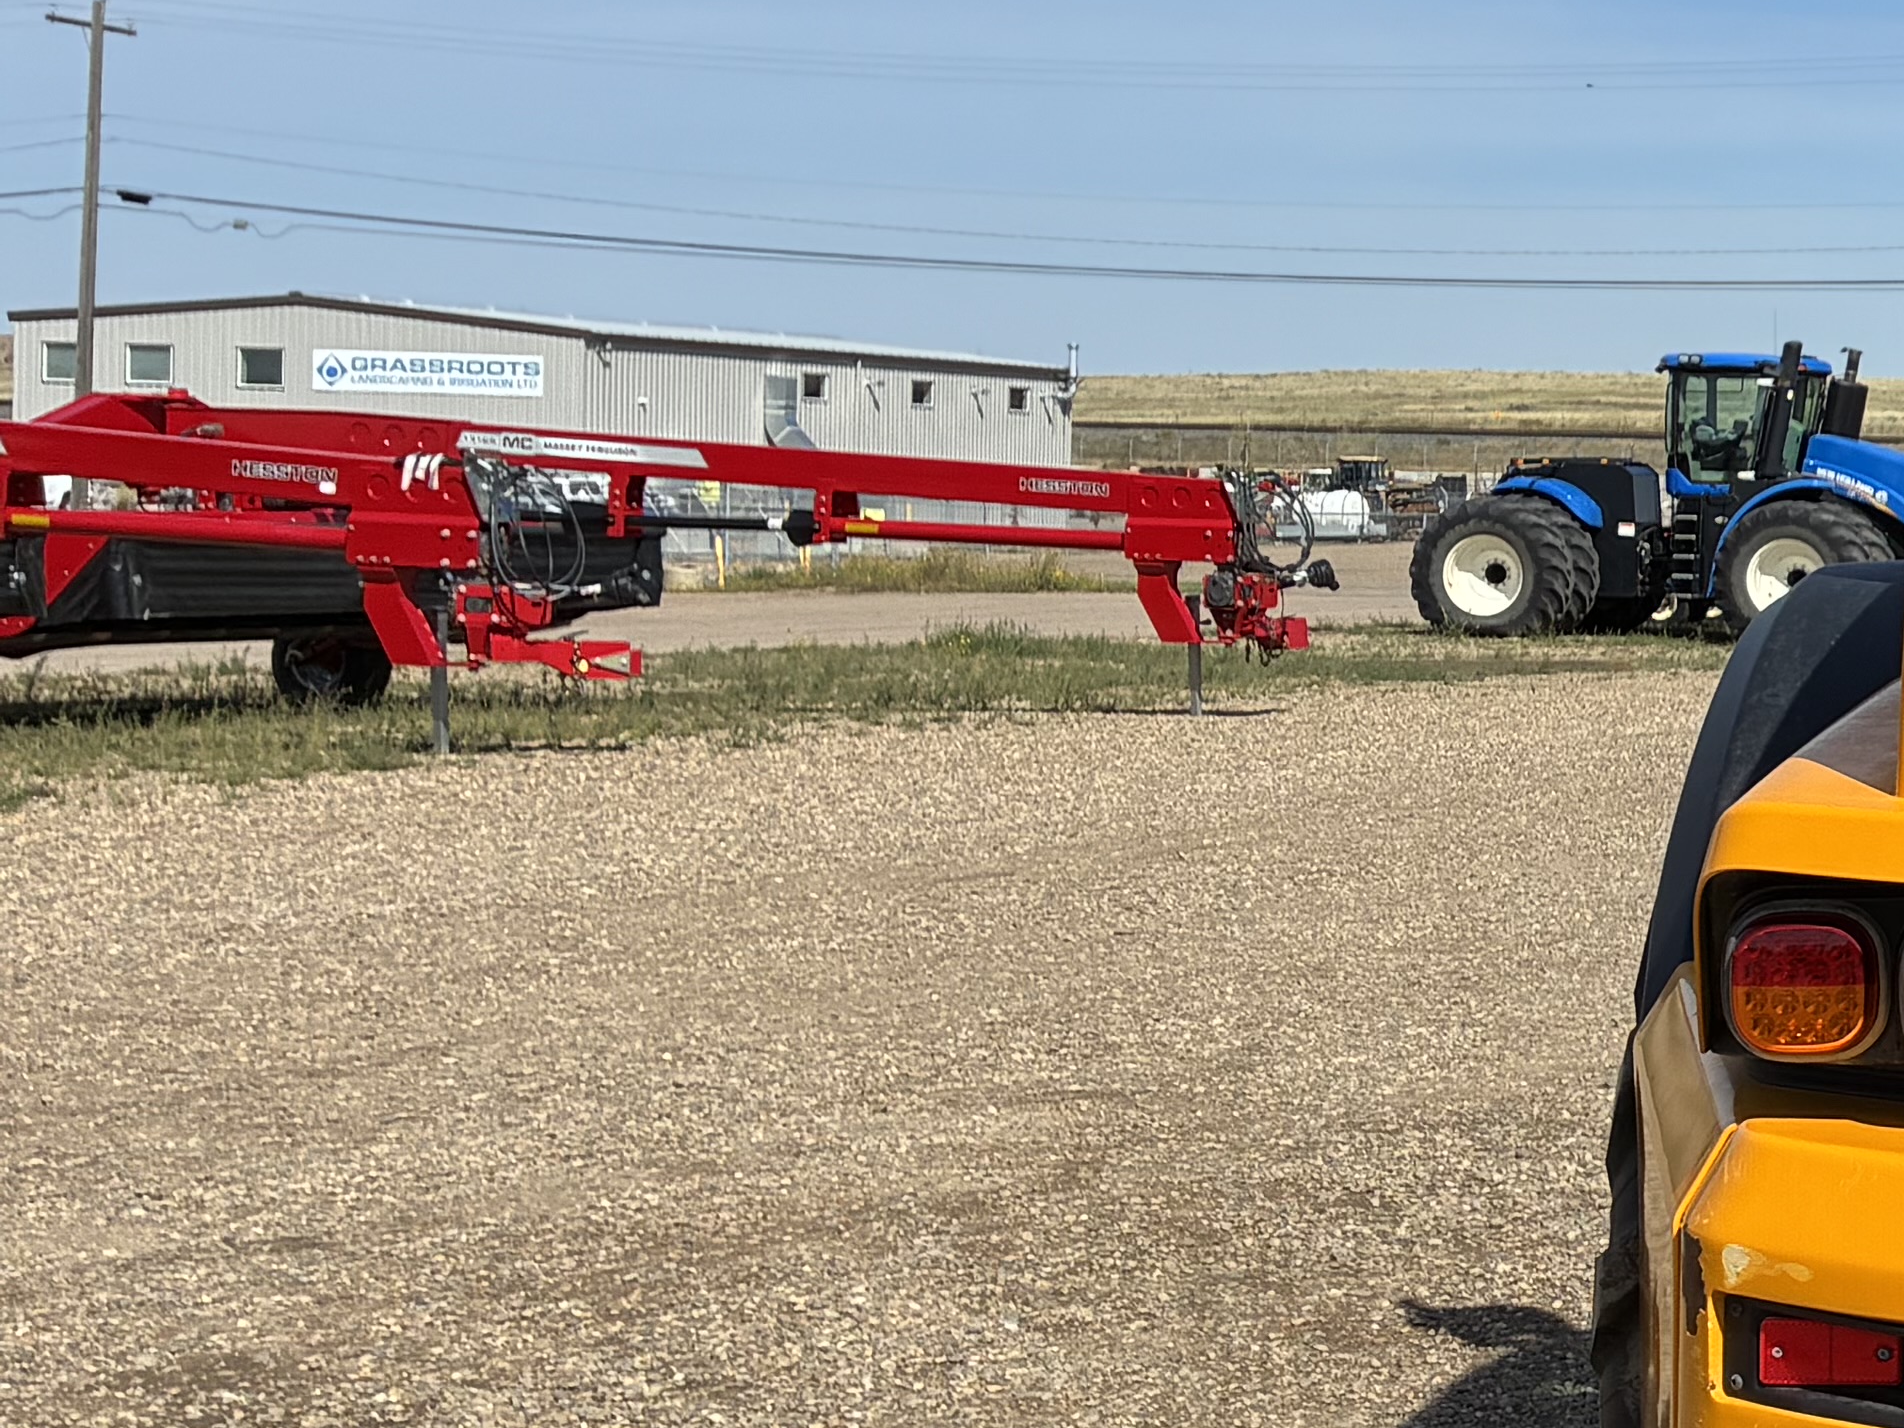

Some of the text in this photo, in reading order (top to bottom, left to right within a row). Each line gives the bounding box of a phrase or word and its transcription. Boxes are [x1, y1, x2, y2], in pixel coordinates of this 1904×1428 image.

[350, 356, 541, 377] GRASSROOTS
[231, 458, 339, 484] HESSTON
[1019, 476, 1110, 498] HESSTON
